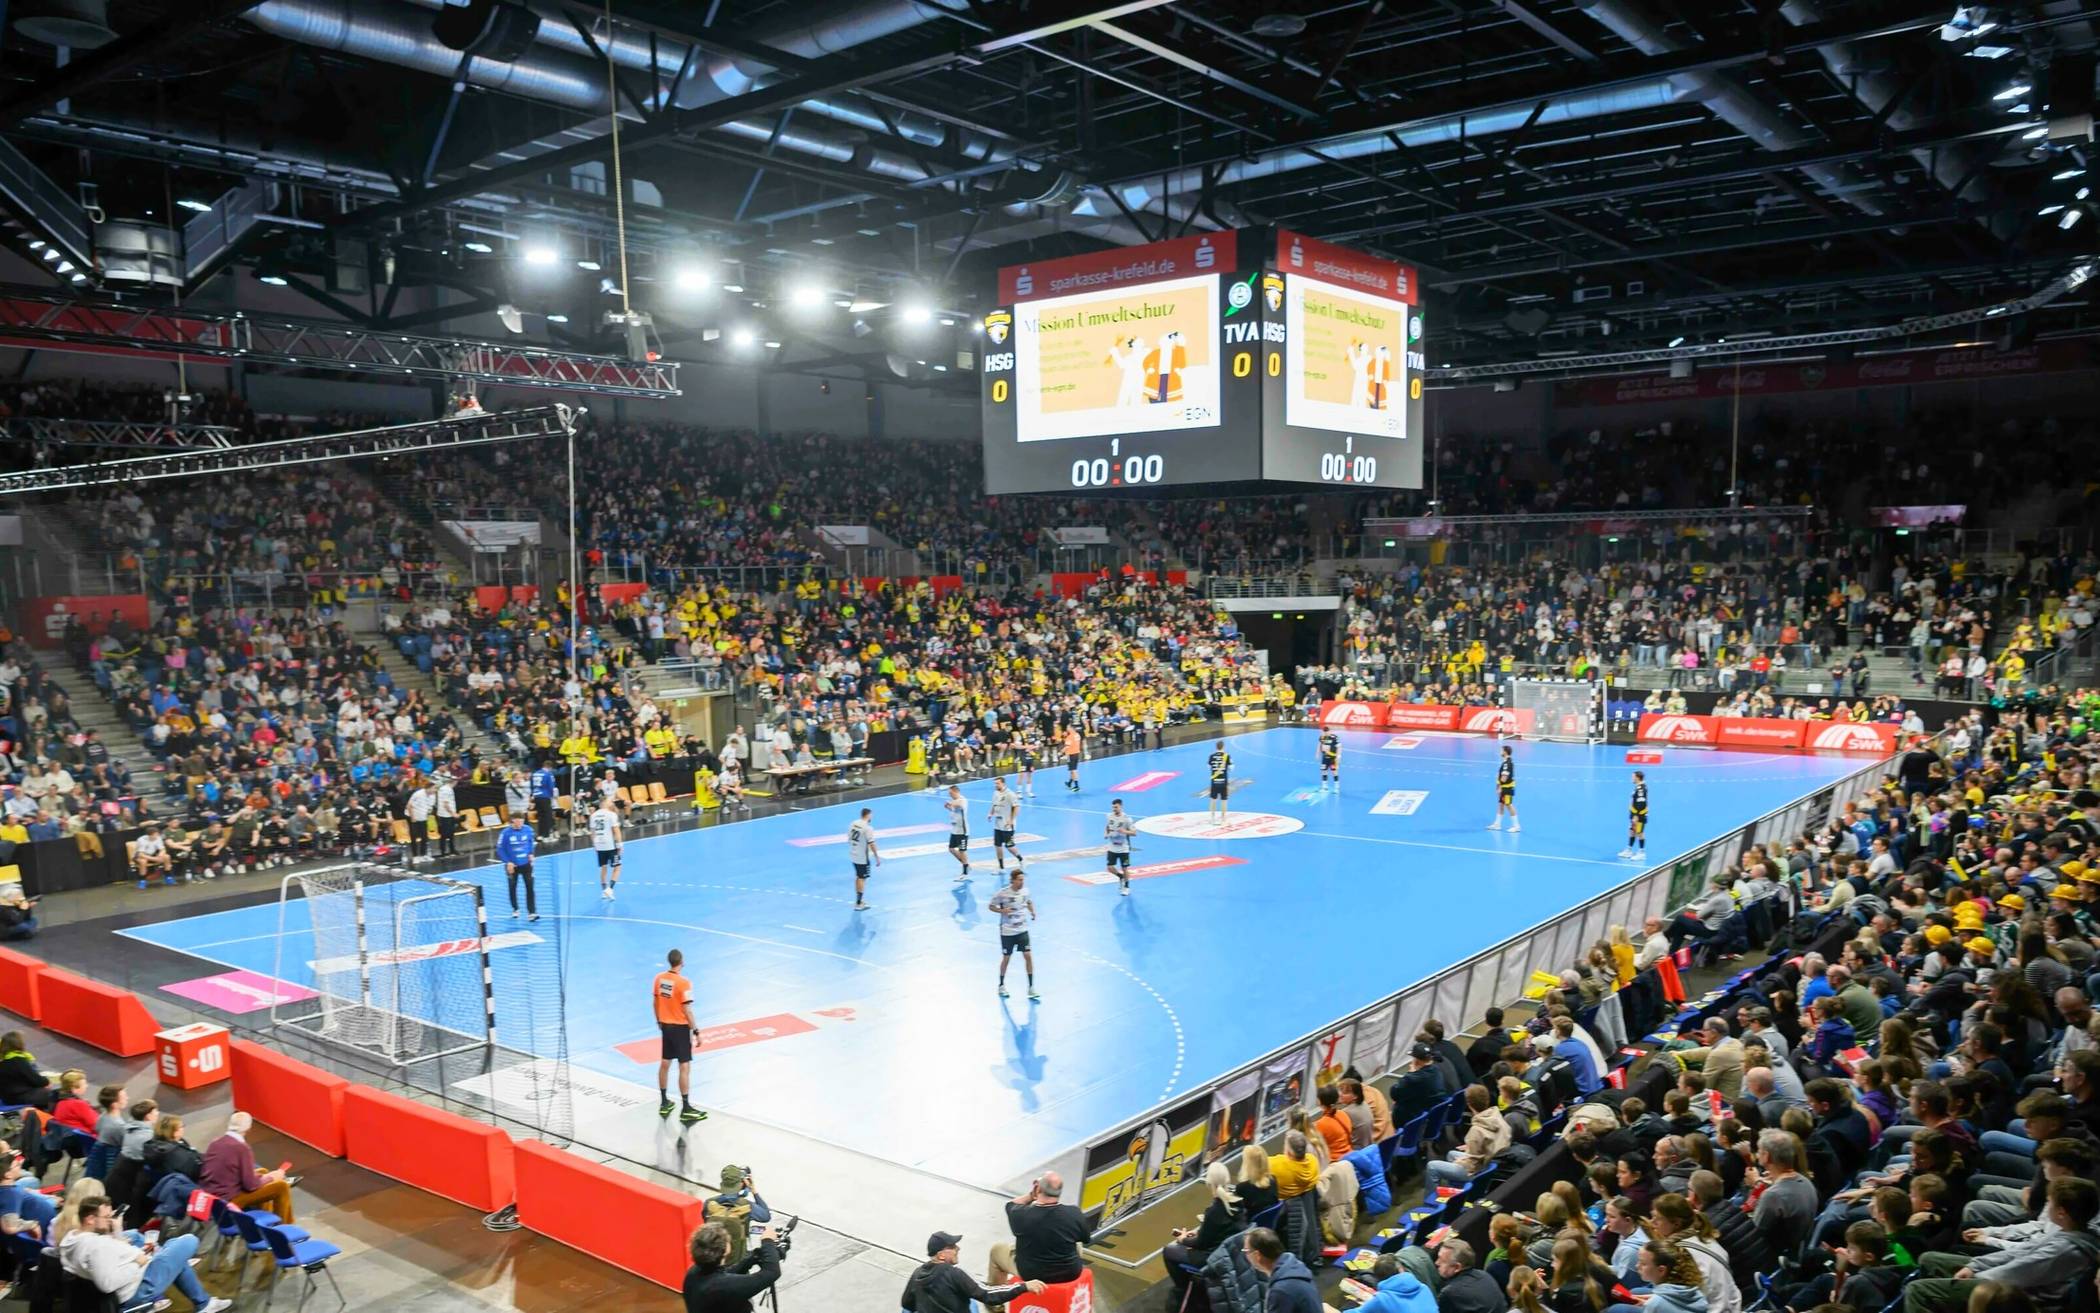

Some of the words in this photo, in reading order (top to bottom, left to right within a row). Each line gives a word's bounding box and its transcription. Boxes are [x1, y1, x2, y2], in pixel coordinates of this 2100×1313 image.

[1049, 260, 1176, 291] sparkasse-krefeld.de
[1024, 315, 1075, 333] Mission
[1077, 302, 1176, 328] Umweltschutz
[1224, 321, 1260, 344] TVA
[1263, 321, 1286, 343] HSG
[985, 352, 1014, 372] HSG
[1233, 352, 1252, 378] 0
[1268, 352, 1281, 377] 0
[1407, 351, 1425, 370] TVA
[992, 379, 1009, 403] 0
[1411, 378, 1421, 400] 0
[1111, 438, 1119, 456] 1
[1345, 436, 1352, 453] 1
[1072, 454, 1163, 487] 00:00
[1321, 453, 1376, 483] 00:00
[1349, 713, 1376, 725] SWK
[1675, 729, 1709, 742] SWK
[1848, 737, 1886, 751] SWK
[1101, 1153, 1185, 1222] EAGLES
